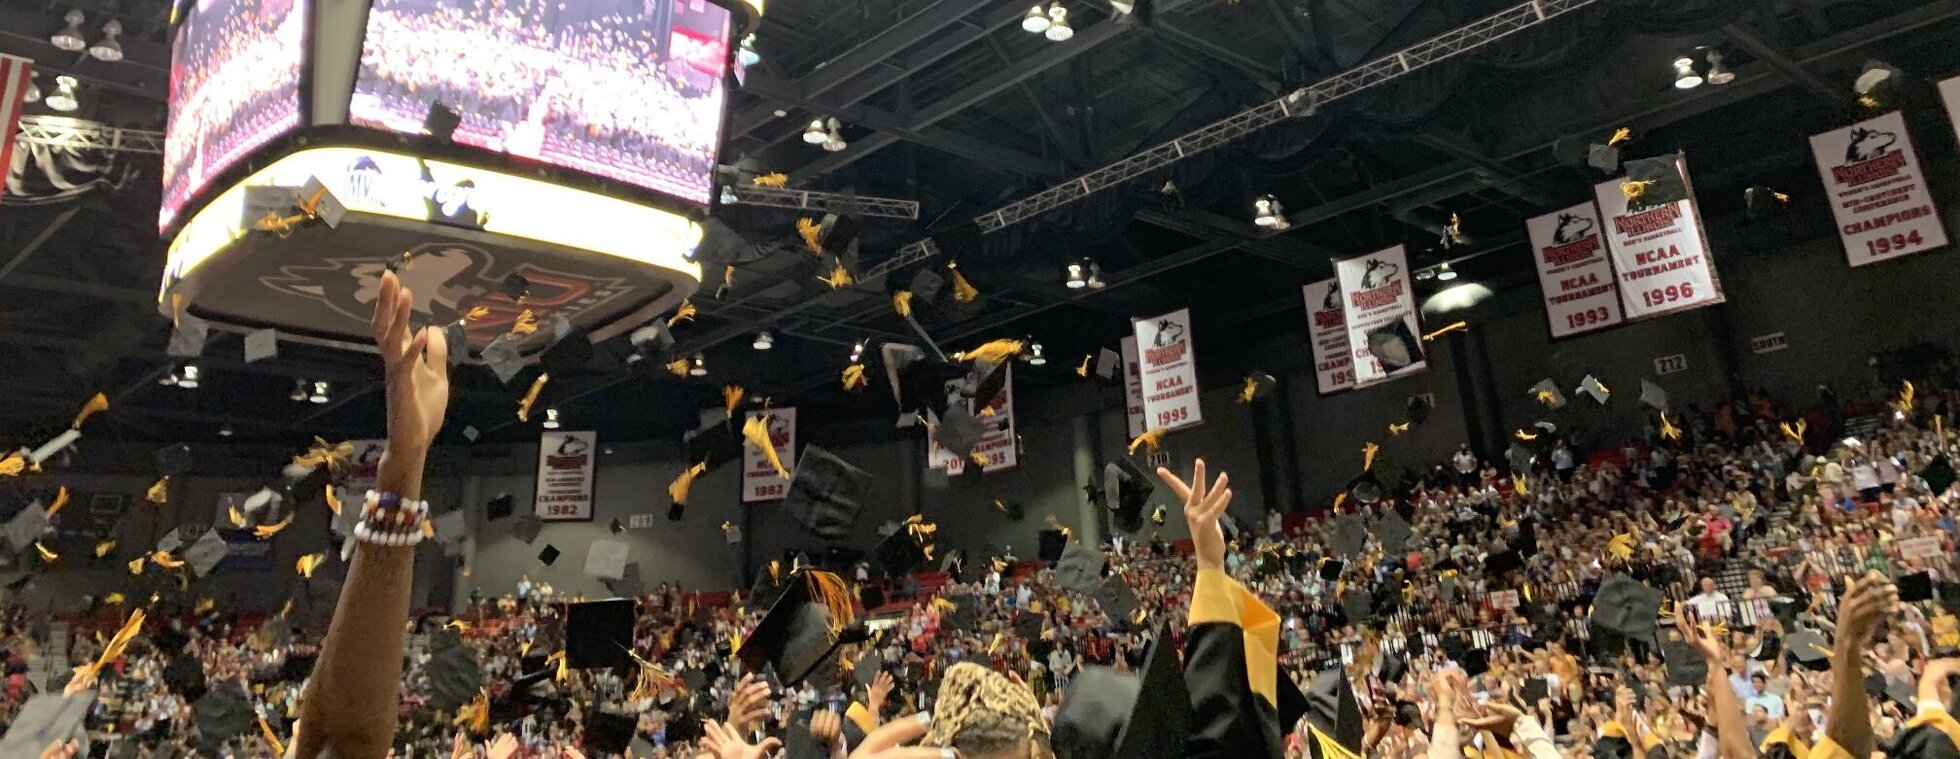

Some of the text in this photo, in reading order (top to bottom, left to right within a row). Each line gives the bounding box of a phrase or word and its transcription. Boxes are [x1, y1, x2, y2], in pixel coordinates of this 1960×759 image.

[1831, 149, 1906, 184] NORTHERN
[1613, 202, 1682, 234] NORTHERN
[1843, 204, 1932, 235] CHAMPIONS
[1866, 229, 1923, 256] 1994
[1635, 244, 1680, 266] NCAA
[1622, 255, 1700, 282] TOURNAMENT
[1560, 272, 1599, 291] NCAA
[1549, 282, 1615, 305] TOURNAMENT
[1642, 282, 1694, 307] 1996
[1566, 306, 1609, 329] 1993
[1659, 356, 1682, 372] 212
[1146, 385, 1194, 403] TOURNAMENT
[1156, 375, 1183, 391] NCAA
[1157, 407, 1188, 426] 1995
[547, 505, 577, 515] 1982
